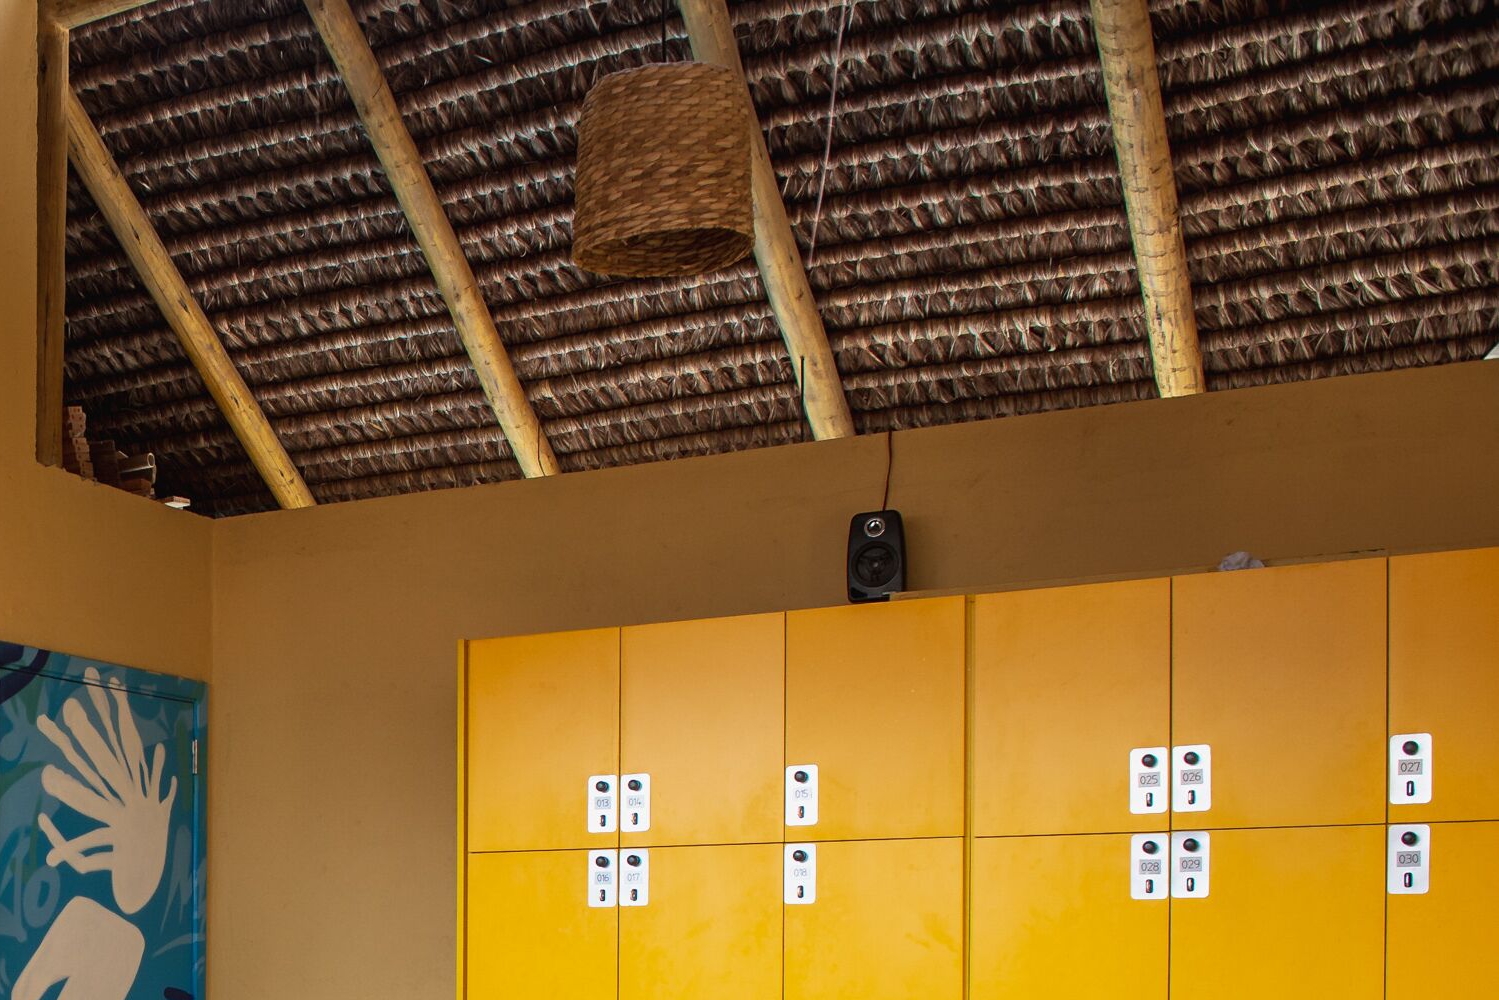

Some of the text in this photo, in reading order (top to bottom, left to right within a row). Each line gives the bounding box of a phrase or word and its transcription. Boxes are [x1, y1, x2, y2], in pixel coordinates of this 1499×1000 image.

[1400, 761, 1421, 773] 027
[1139, 774, 1159, 785] 025
[1182, 771, 1201, 783] 026
[596, 798, 609, 808] 013
[1181, 858, 1201, 870] 029
[1398, 853, 1419, 865] 030
[1140, 861, 1160, 873] 028
[596, 873, 609, 883] 016
